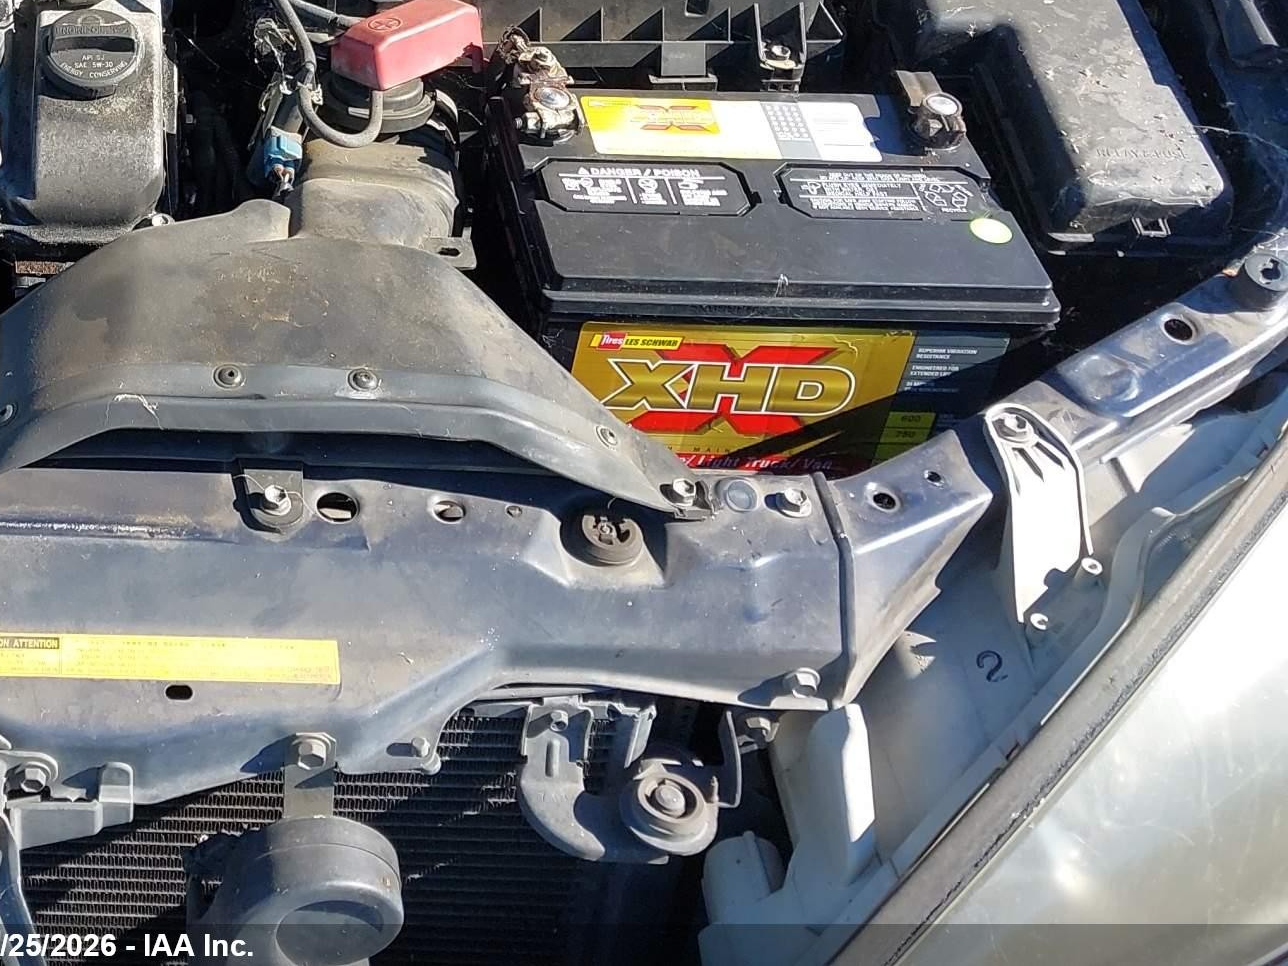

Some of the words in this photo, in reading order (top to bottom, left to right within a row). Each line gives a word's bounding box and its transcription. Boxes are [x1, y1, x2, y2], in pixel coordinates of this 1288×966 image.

[591, 168, 641, 176] DANGER
[653, 169, 700, 177] POISON
[601, 334, 624, 345] Tires
[625, 338, 640, 346] LES
[640, 338, 678, 347] SCHWAB
[601, 358, 856, 416] XHD
[696, 455, 739, 468] Light
[13, 638, 58, 649] ATTENTION
